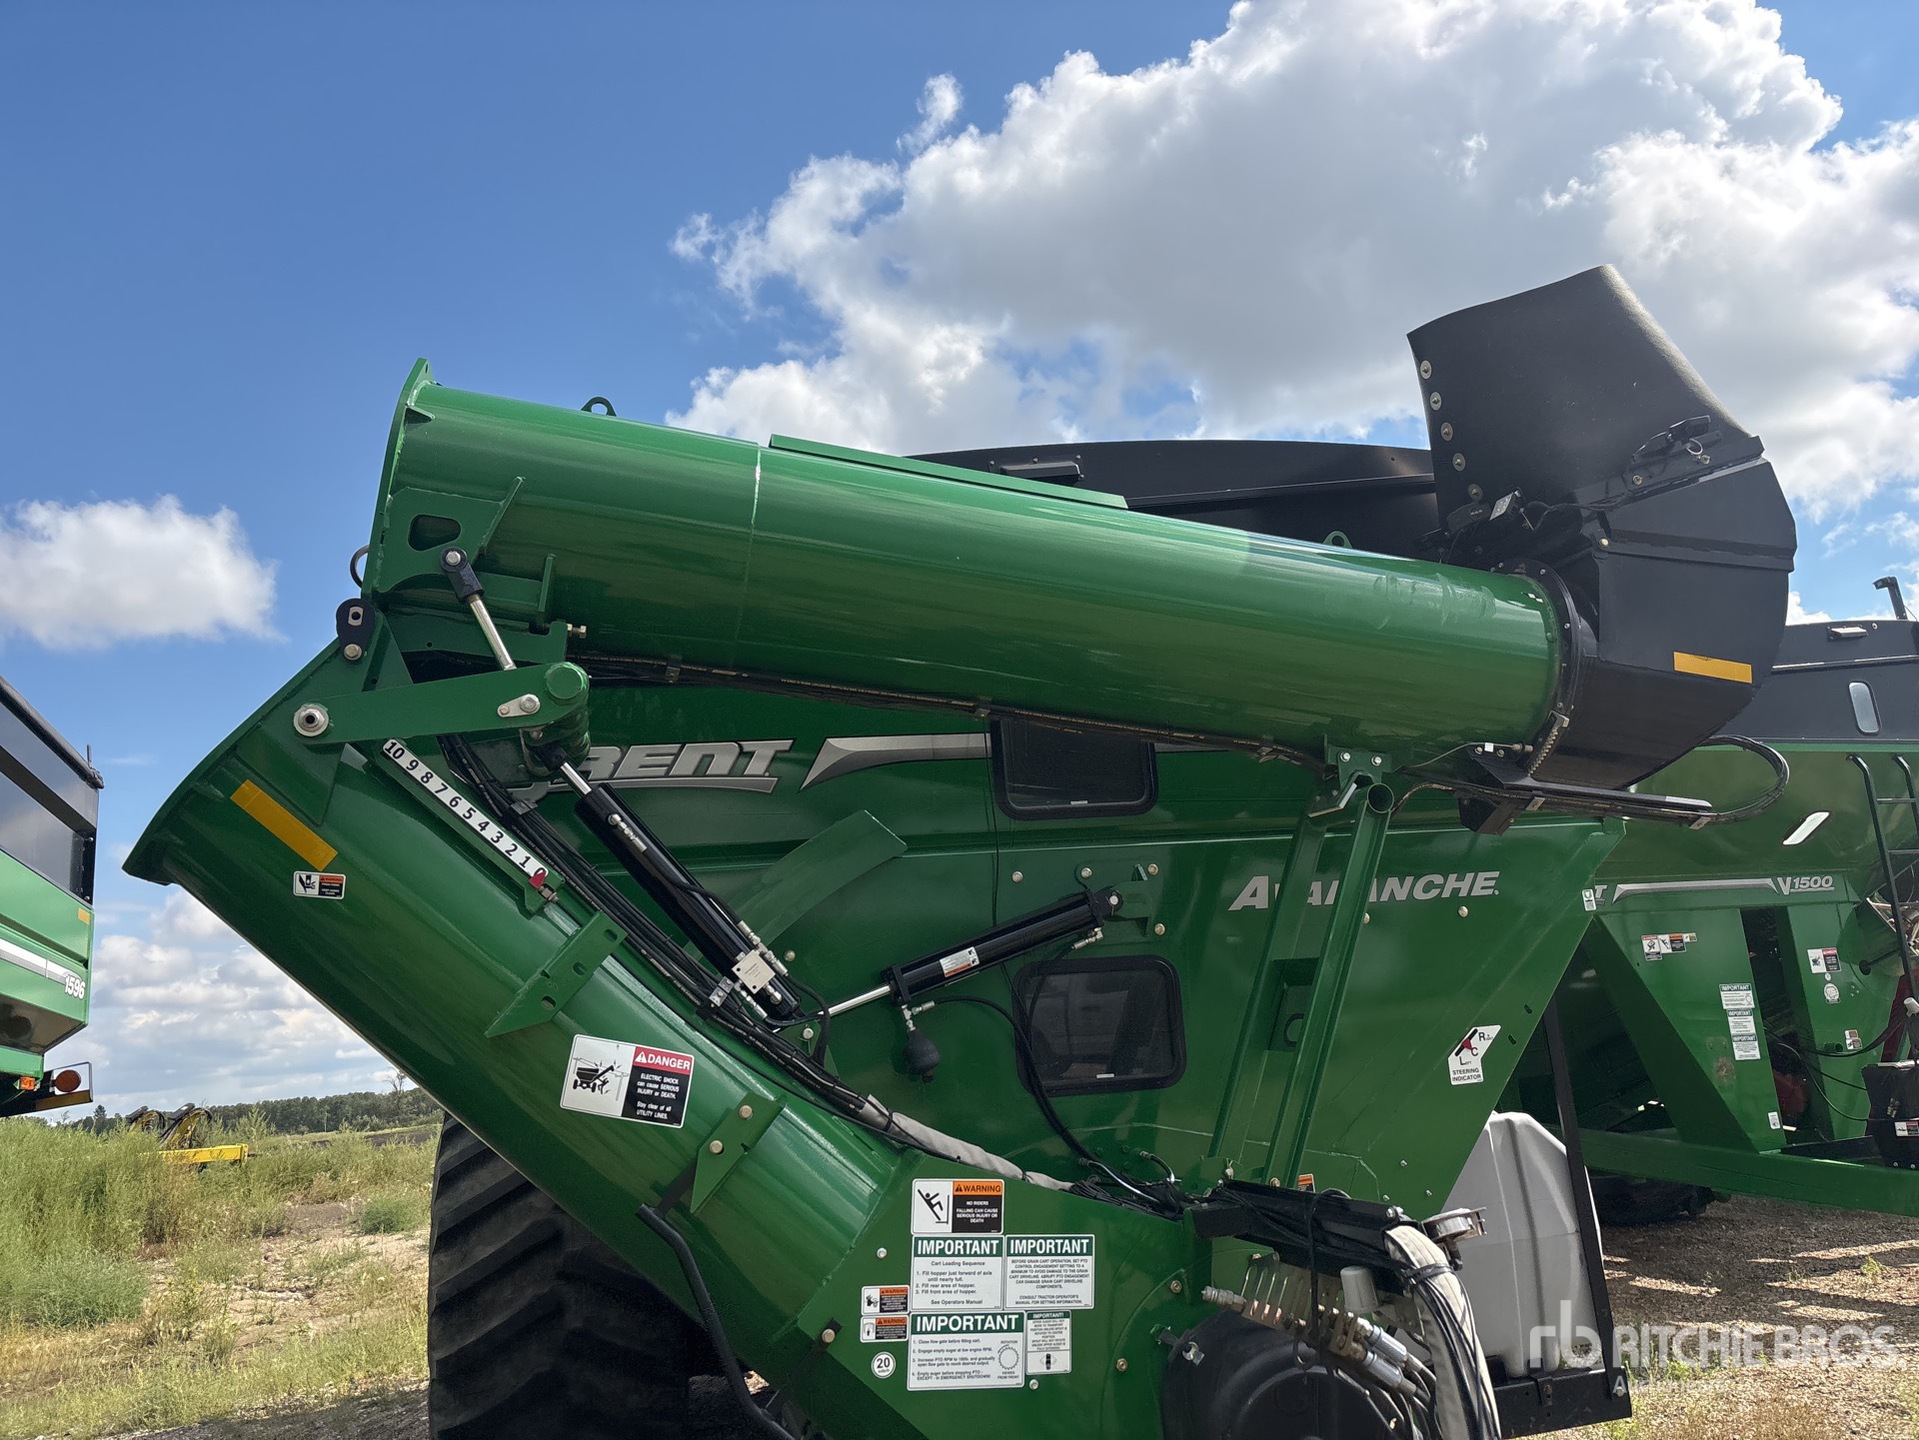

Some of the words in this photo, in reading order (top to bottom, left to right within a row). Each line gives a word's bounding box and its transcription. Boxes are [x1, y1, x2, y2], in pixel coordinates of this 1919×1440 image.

[552, 739, 796, 783] RENT
[385, 742, 405, 759] 10
[406, 760, 419, 771] 9
[420, 772, 433, 784] 8
[435, 783, 448, 794] 7
[449, 796, 462, 808] 6
[463, 807, 476, 819] 5
[478, 820, 490, 832] 4
[491, 831, 504, 843] 3
[505, 844, 518, 856] 2
[519, 856, 531, 868] 1
[1228, 871, 1500, 911] AANCHE
[1777, 876, 1833, 896] V1500
[64, 974, 86, 999] 1596
[648, 1054, 690, 1070] DANGER
[660, 1084, 679, 1092] SERIOUS
[918, 1240, 999, 1254] IMPORTANT
[1011, 1239, 1089, 1253] IMPORTANT
[917, 1315, 1018, 1331] IMPORTANT
[877, 1358, 890, 1368] 20
